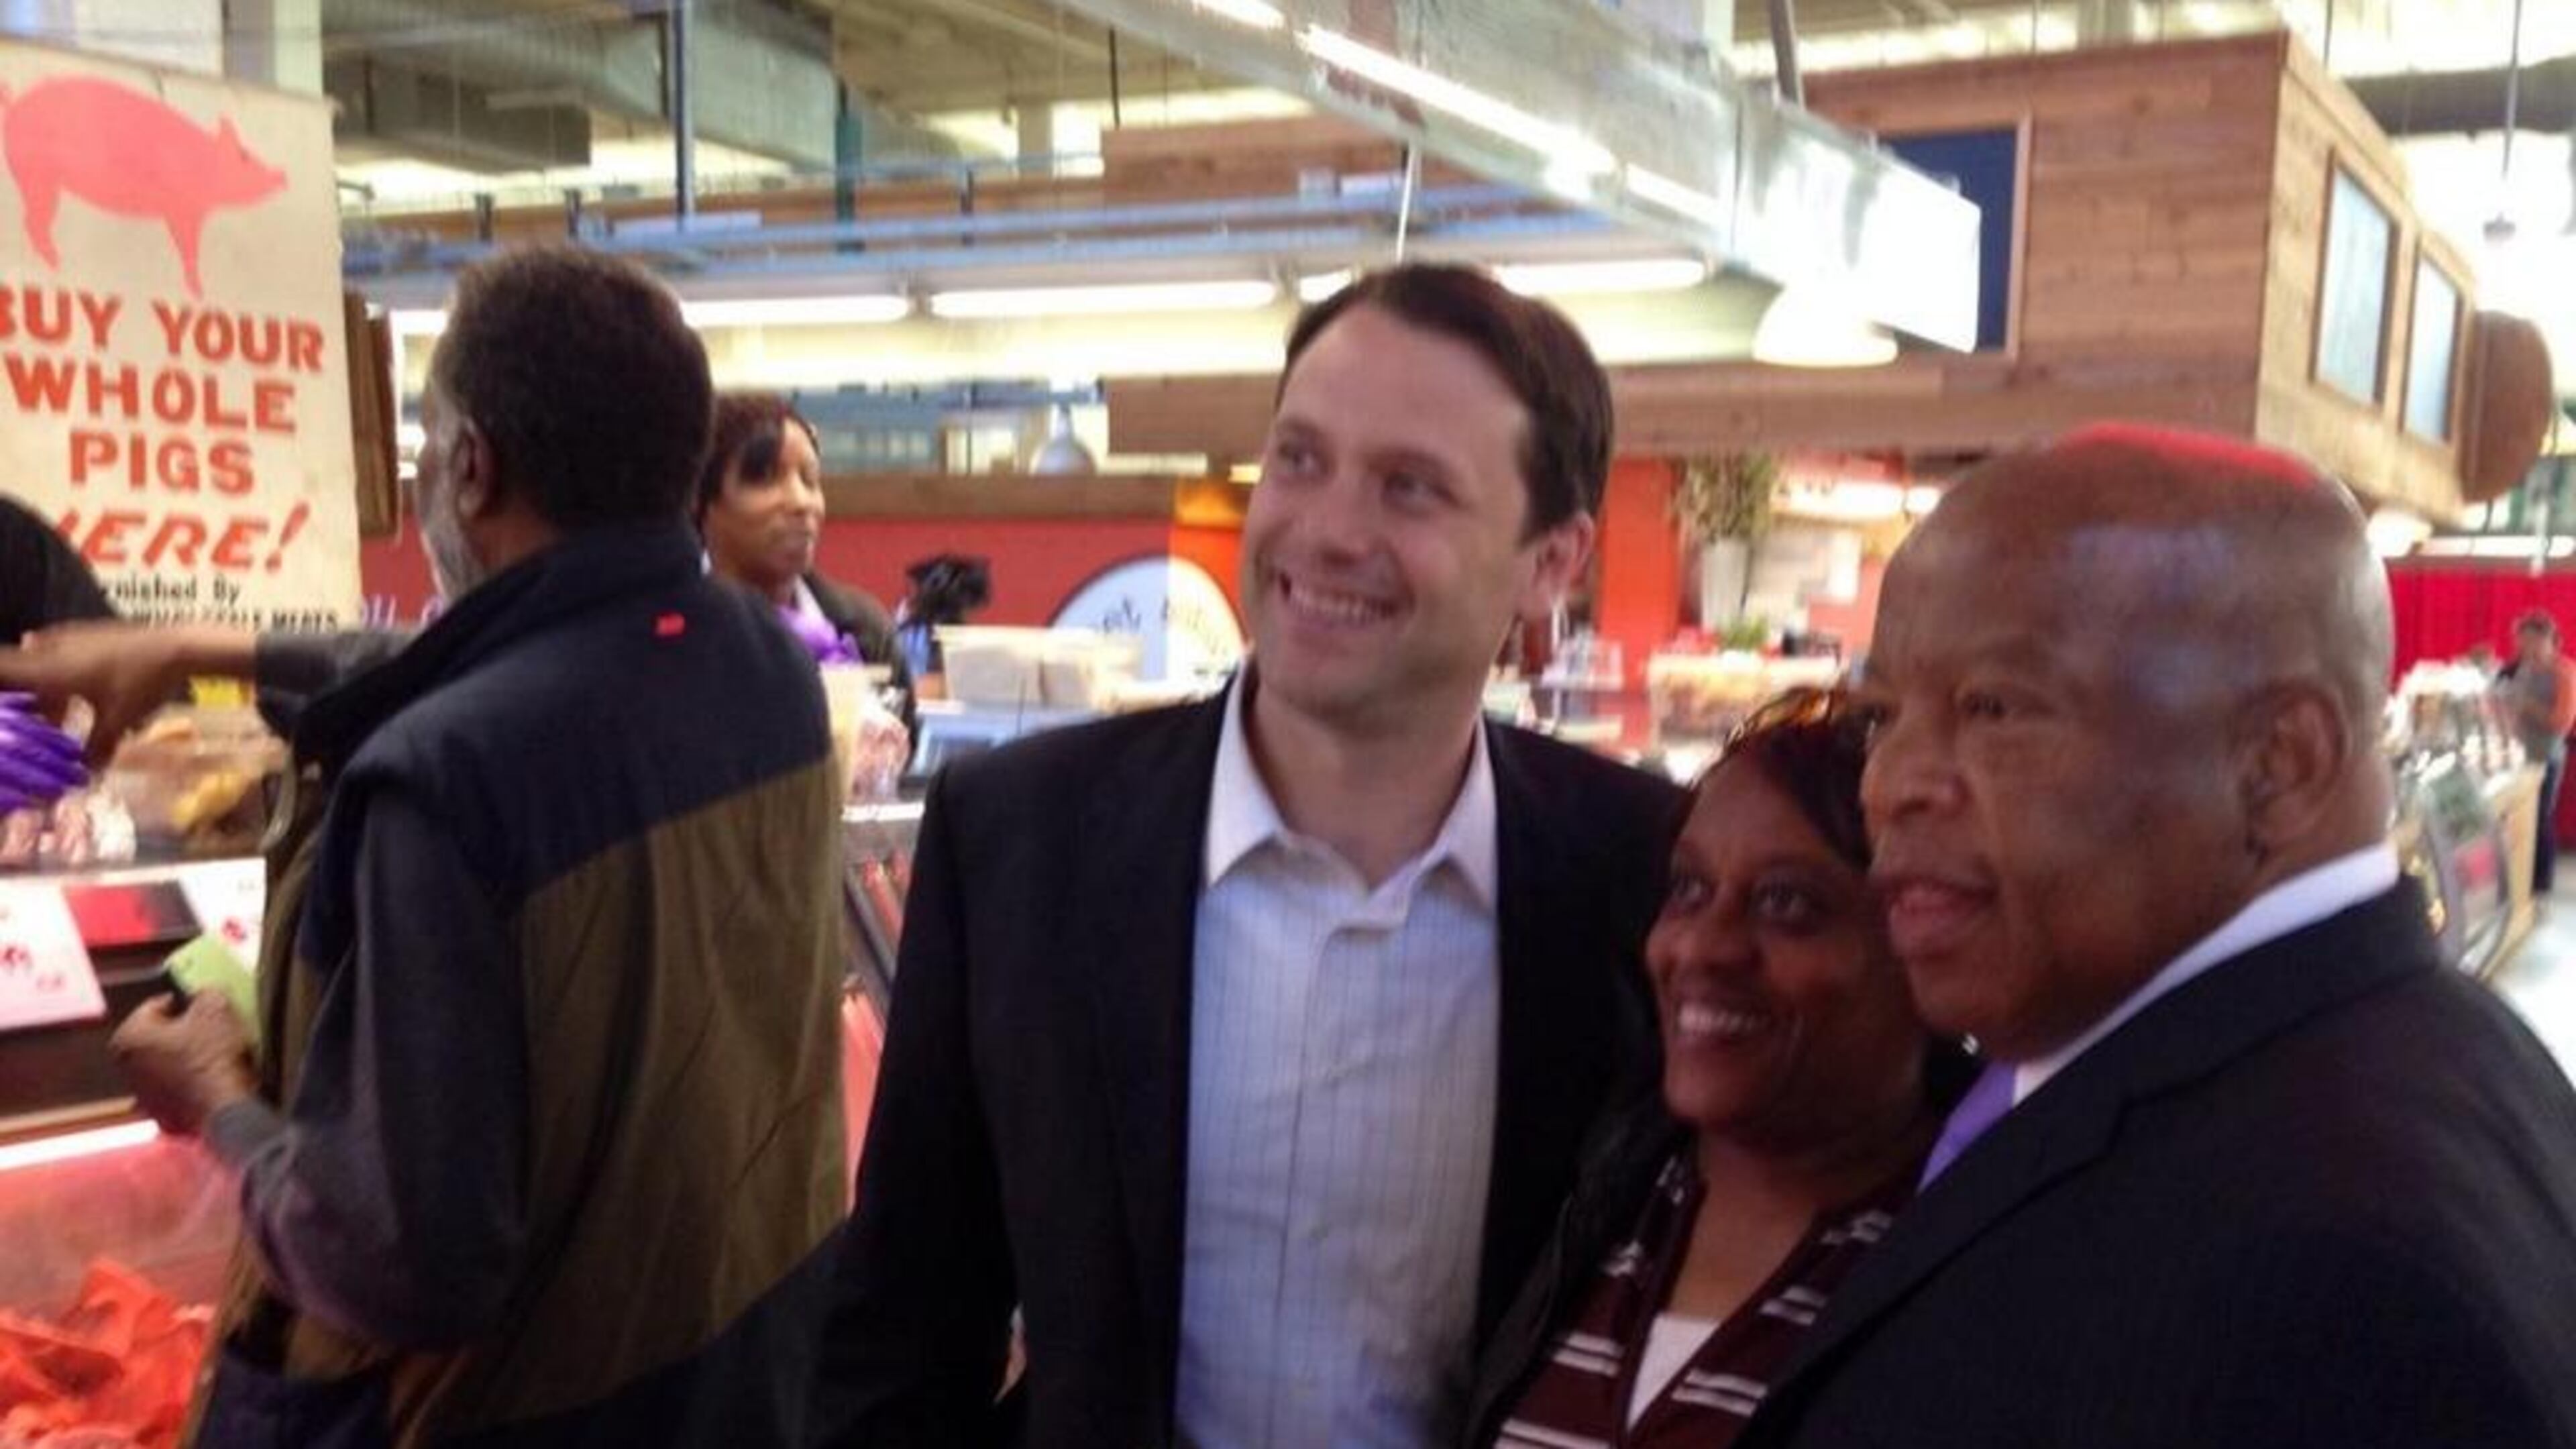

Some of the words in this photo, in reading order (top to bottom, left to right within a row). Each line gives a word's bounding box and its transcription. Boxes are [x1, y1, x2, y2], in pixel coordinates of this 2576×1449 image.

[152, 297, 324, 372] YOUR
[4, 352, 296, 433] WHOLE
[69, 430, 254, 496] PIGS
[214, 571, 240, 608] By
